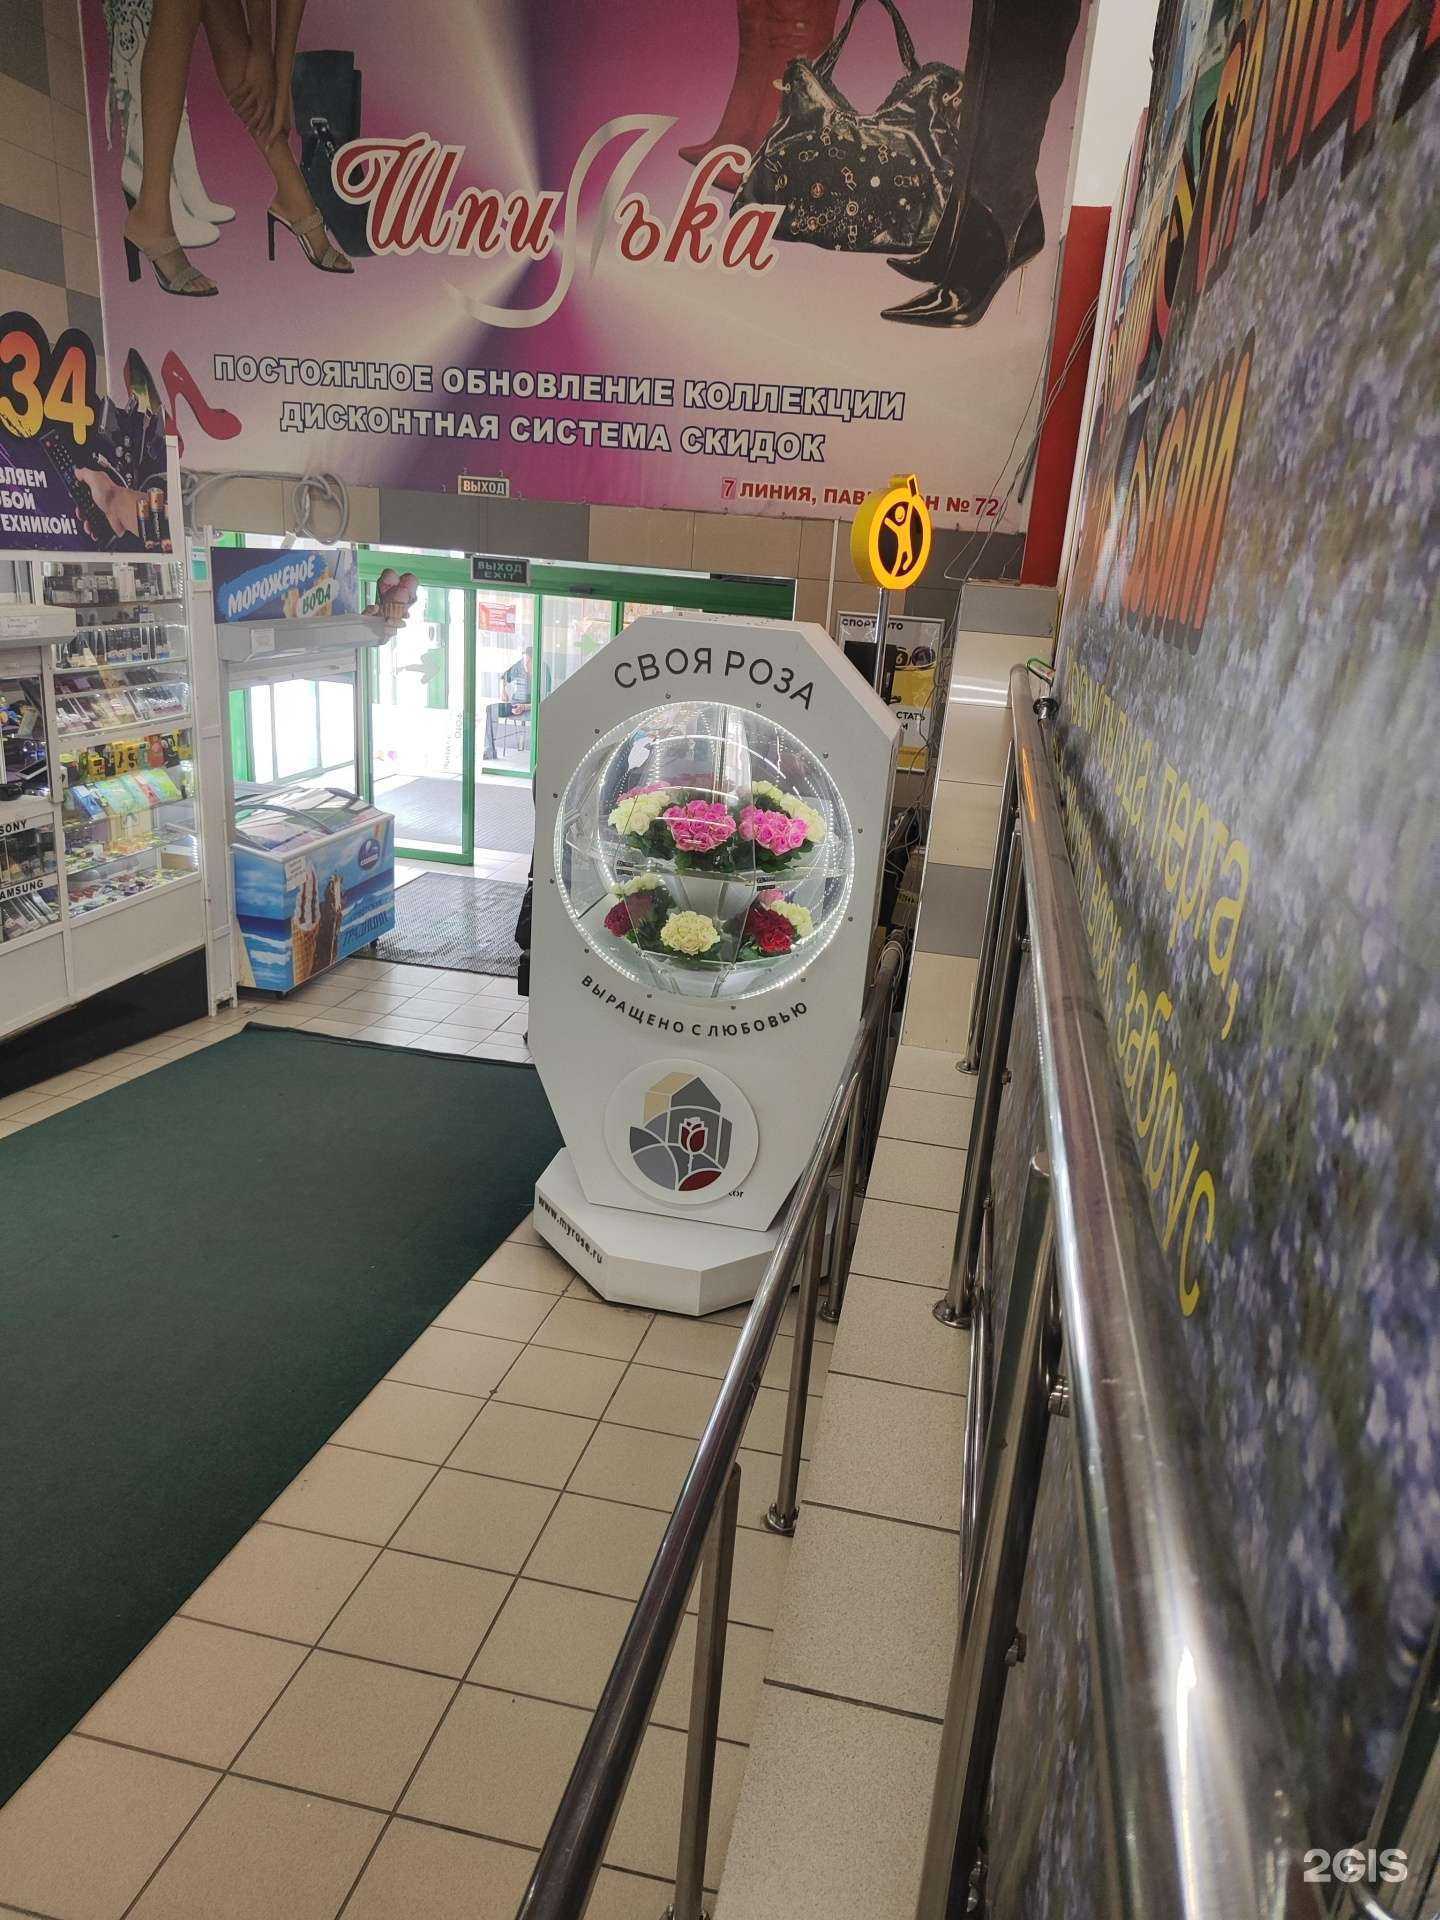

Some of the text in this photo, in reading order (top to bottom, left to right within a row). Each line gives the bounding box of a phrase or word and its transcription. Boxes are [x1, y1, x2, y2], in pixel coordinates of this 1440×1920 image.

[0, 331, 95, 445] 34
[213, 354, 906, 421] ПОСТОЯННОЕ ОБНОВЛЕНИЕ КОЛЛЕКЦИИ
[280, 402, 827, 464] ДИСКОНТНАЯ СИСТЕМА СКИДОК
[0, 488, 36, 510] БОЙ
[463, 479, 505, 495] ВЫХОД
[723, 479, 736, 497] 7
[739, 482, 817, 506] ЛИНИЯ,
[946, 497, 970, 513] №
[975, 497, 999, 517] 72
[227, 554, 316, 618] МОРОЖЕНОЕ
[302, 583, 332, 614] ВОДА
[478, 561, 522, 574] ВЫХОД
[613, 647, 815, 710] СВОЯ РОЗА
[0, 820, 27, 834] SONY
[1150, 762, 1252, 1041] перга,
[581, 974, 808, 1038] ВЫРАЩЕНО С ЛЮБОВЬЮ
[1117, 962, 1216, 1317] забрус
